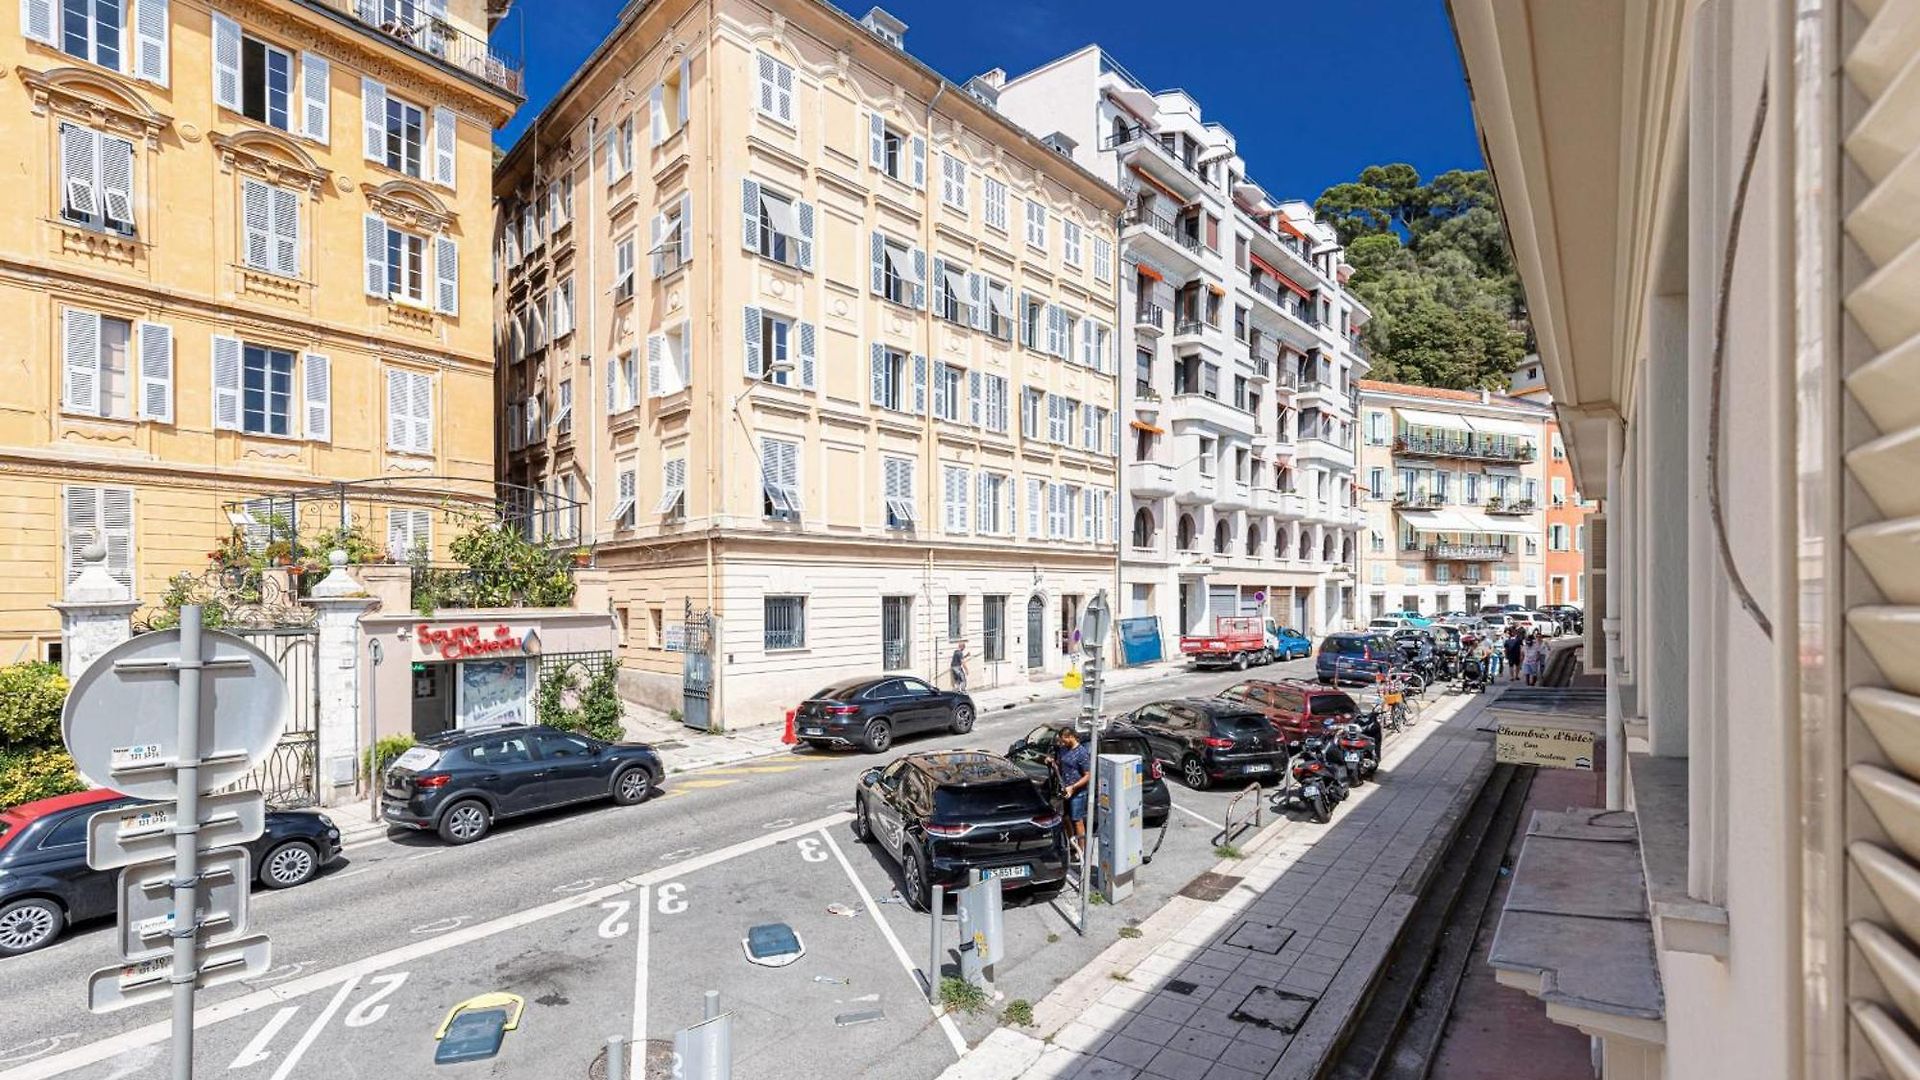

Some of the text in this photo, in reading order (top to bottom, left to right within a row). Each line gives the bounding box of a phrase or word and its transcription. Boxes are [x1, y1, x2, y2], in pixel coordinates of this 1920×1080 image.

[416, 624, 478, 645] Sauna
[1496, 725, 1594, 743] Chambres d'hôtes
[796, 838, 829, 863] 3
[657, 882, 689, 914] 3
[598, 900, 631, 939] 2
[959, 907, 969, 922] 3
[344, 971, 411, 1027] 2
[227, 1005, 302, 1069] 1
